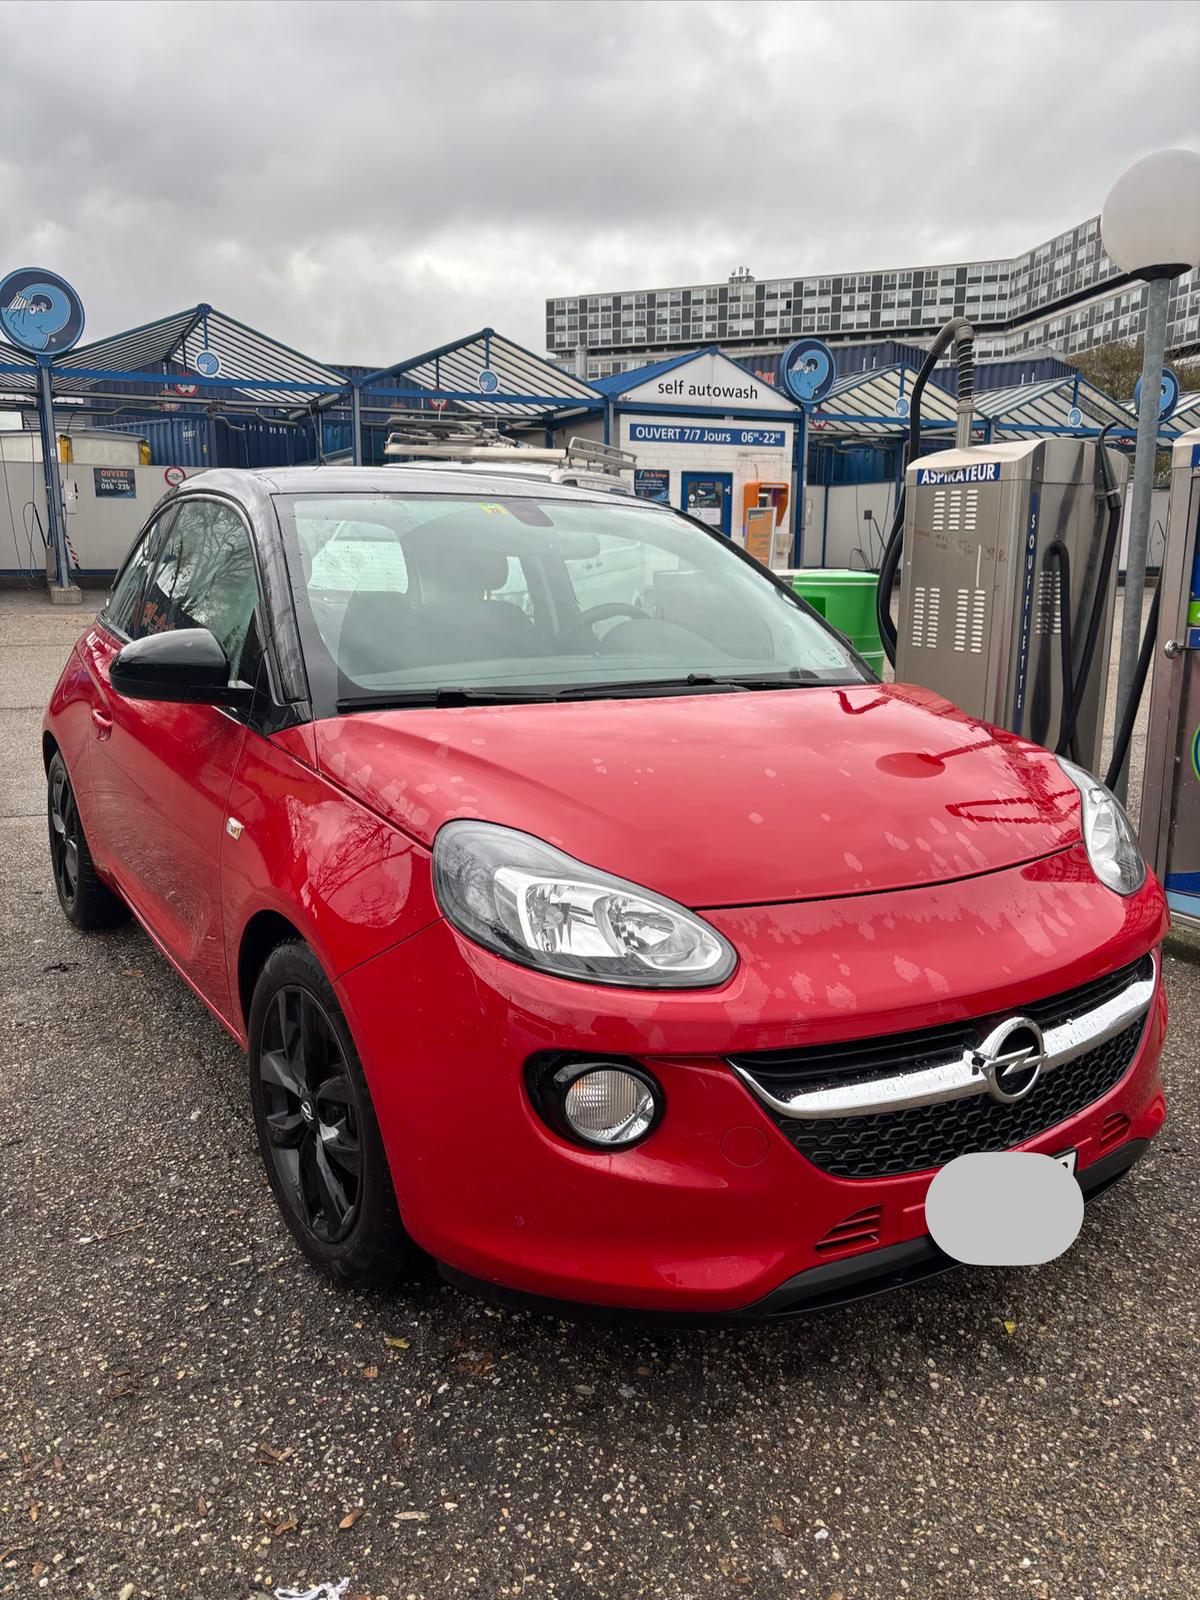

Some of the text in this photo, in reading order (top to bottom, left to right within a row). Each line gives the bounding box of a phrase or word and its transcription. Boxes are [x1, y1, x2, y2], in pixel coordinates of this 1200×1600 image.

[658, 380, 758, 400] self autowash
[636, 427, 681, 440] OUVERT
[684, 429, 701, 441] 7/7
[703, 431, 731, 442] Jours
[921, 464, 996, 485] ASPIRATEUR
[67, 492, 74, 500] 2
[1017, 514, 1036, 709] SOUFFLETTE
